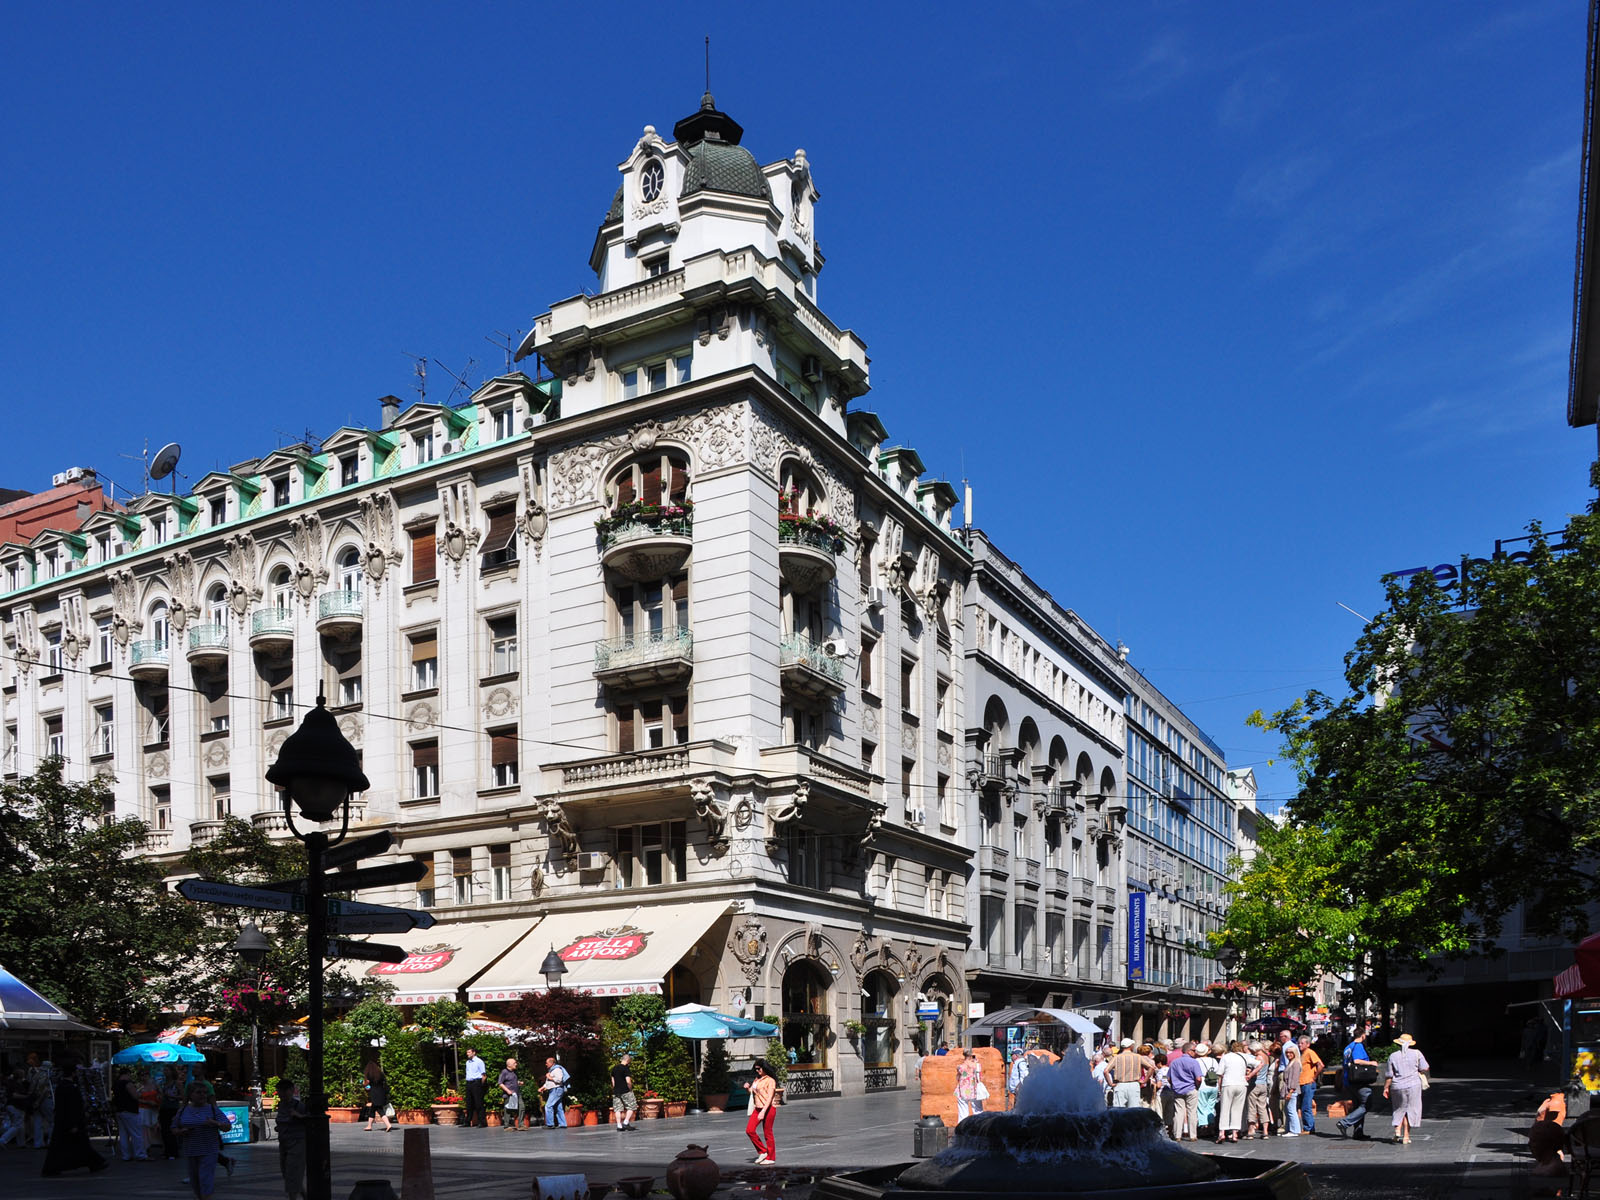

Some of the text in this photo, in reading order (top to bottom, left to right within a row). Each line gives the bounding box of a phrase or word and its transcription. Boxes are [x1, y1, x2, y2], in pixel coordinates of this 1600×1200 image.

[576, 940, 633, 950] STELLA
[566, 948, 629, 958] ARTOIS
[401, 956, 443, 964] TELLA
[382, 963, 437, 971] ARTOIS
